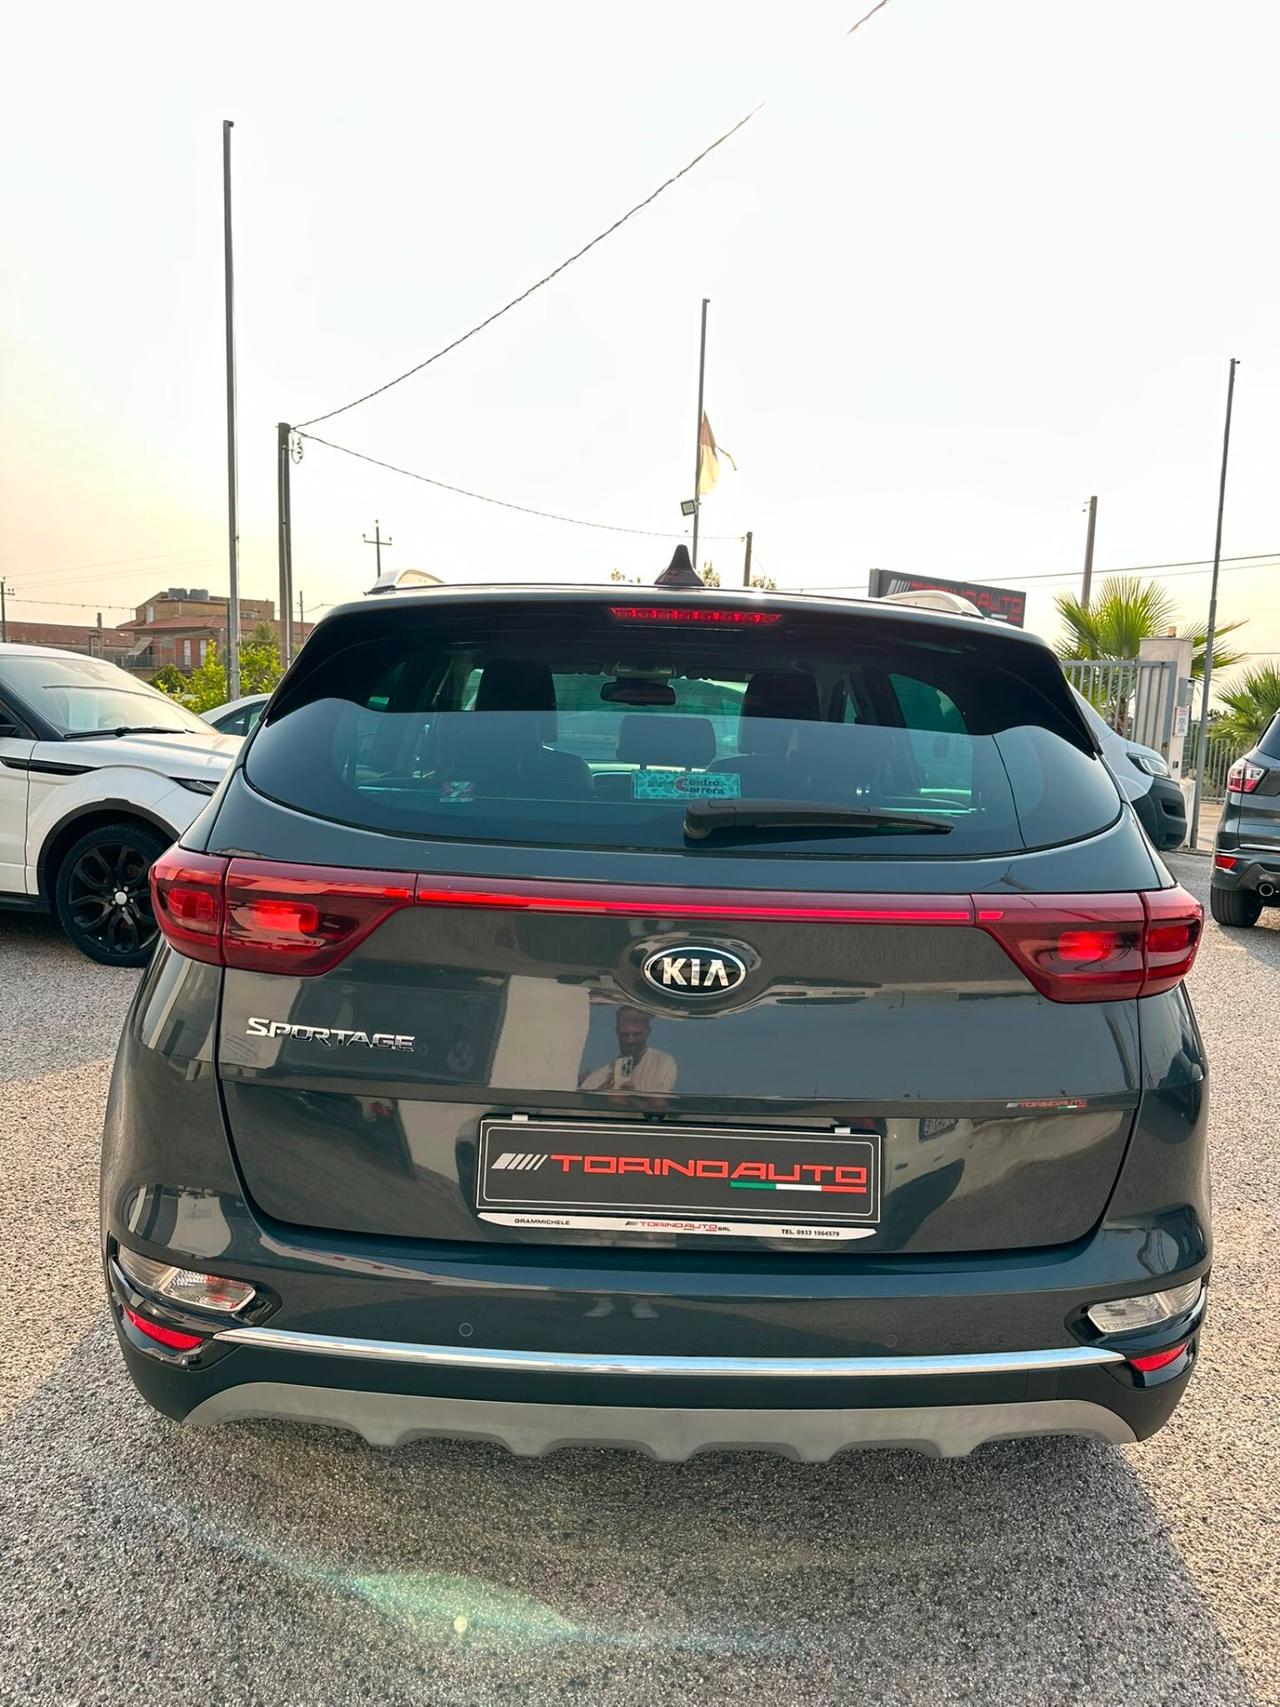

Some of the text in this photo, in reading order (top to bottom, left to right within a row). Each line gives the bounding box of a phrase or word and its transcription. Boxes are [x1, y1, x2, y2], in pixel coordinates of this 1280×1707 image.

[662, 957, 729, 987] KIA
[246, 1017, 416, 1052] SPORTAGE
[551, 1153, 868, 1184] TORINOAUTO
[514, 1217, 570, 1226] GRAMMICHELE
[640, 1221, 718, 1231] TORINOAUTO
